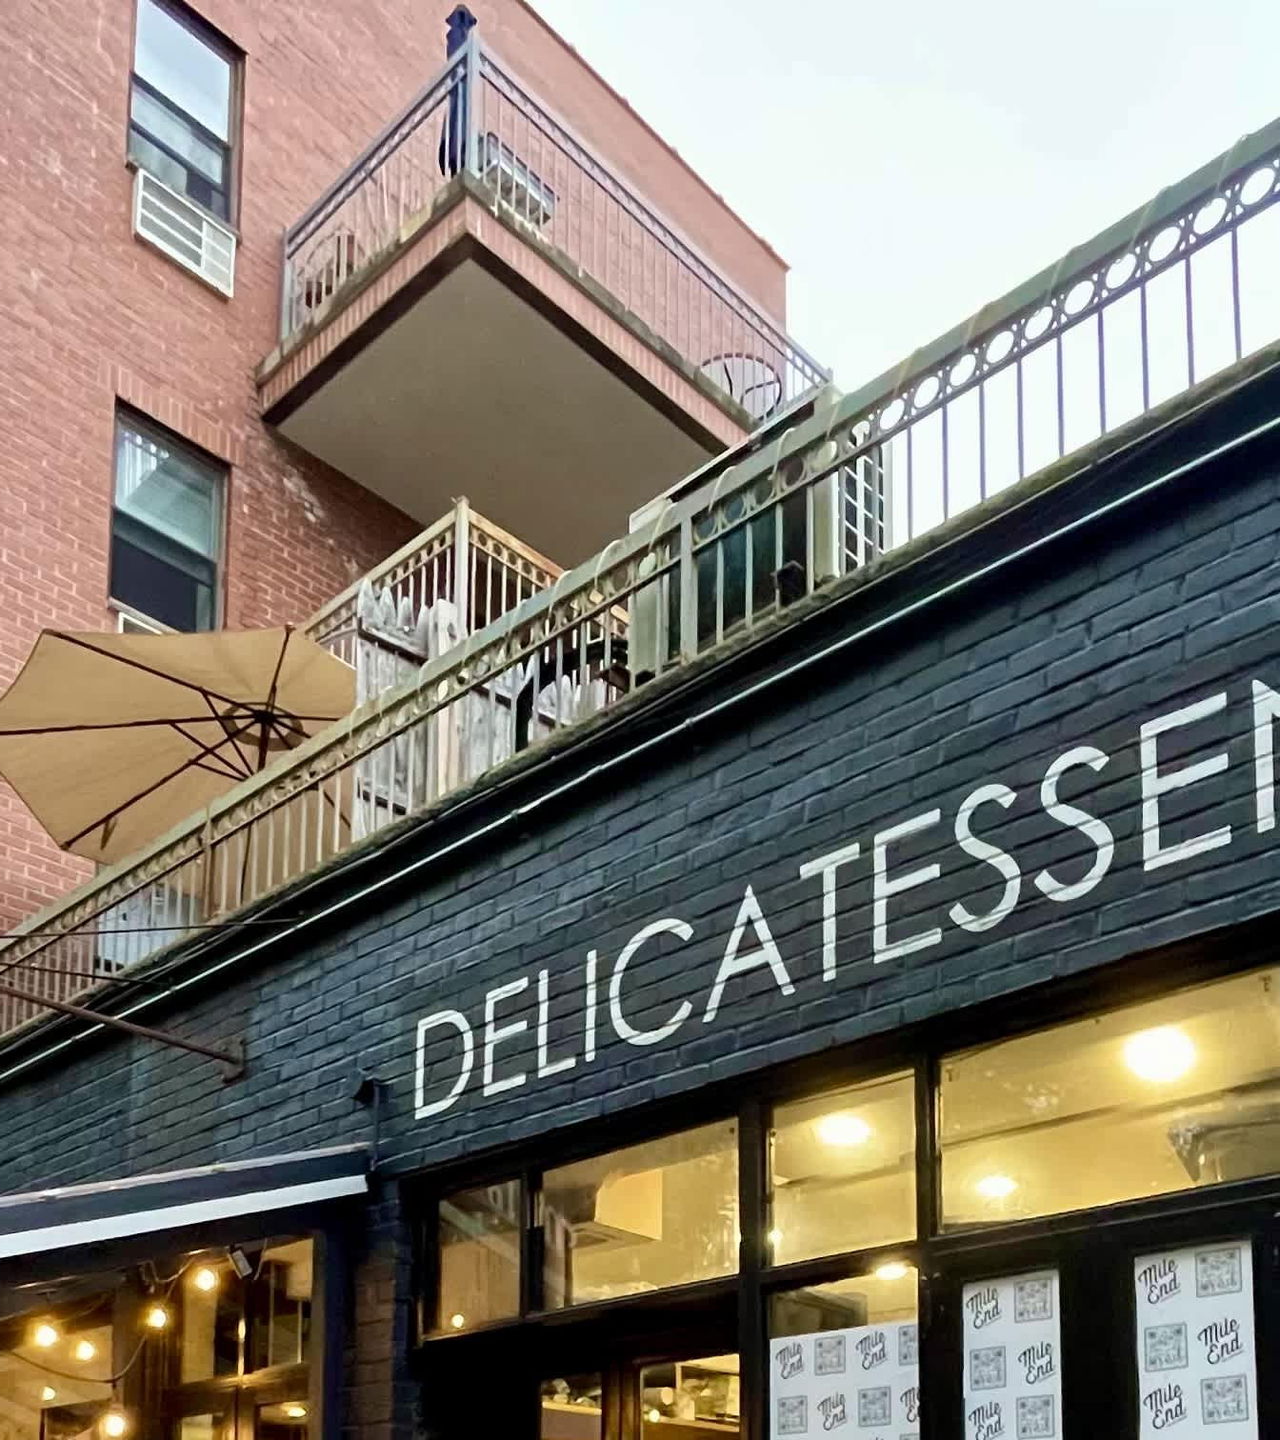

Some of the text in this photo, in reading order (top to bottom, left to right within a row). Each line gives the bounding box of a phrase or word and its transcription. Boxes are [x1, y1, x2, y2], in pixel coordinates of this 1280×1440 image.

[1138, 1259, 1178, 1287] Mile
[966, 1287, 998, 1311] Mile
[1147, 1276, 1180, 1304] End
[973, 1303, 1000, 1329] End
[1197, 1318, 1240, 1346] Mile
[1018, 1342, 1052, 1367] Mile
[1207, 1332, 1243, 1365] End
[1026, 1358, 1054, 1385] End
[1143, 1383, 1183, 1412] Mile
[968, 1402, 1001, 1426] Mile
[1152, 1400, 1186, 1429] End
